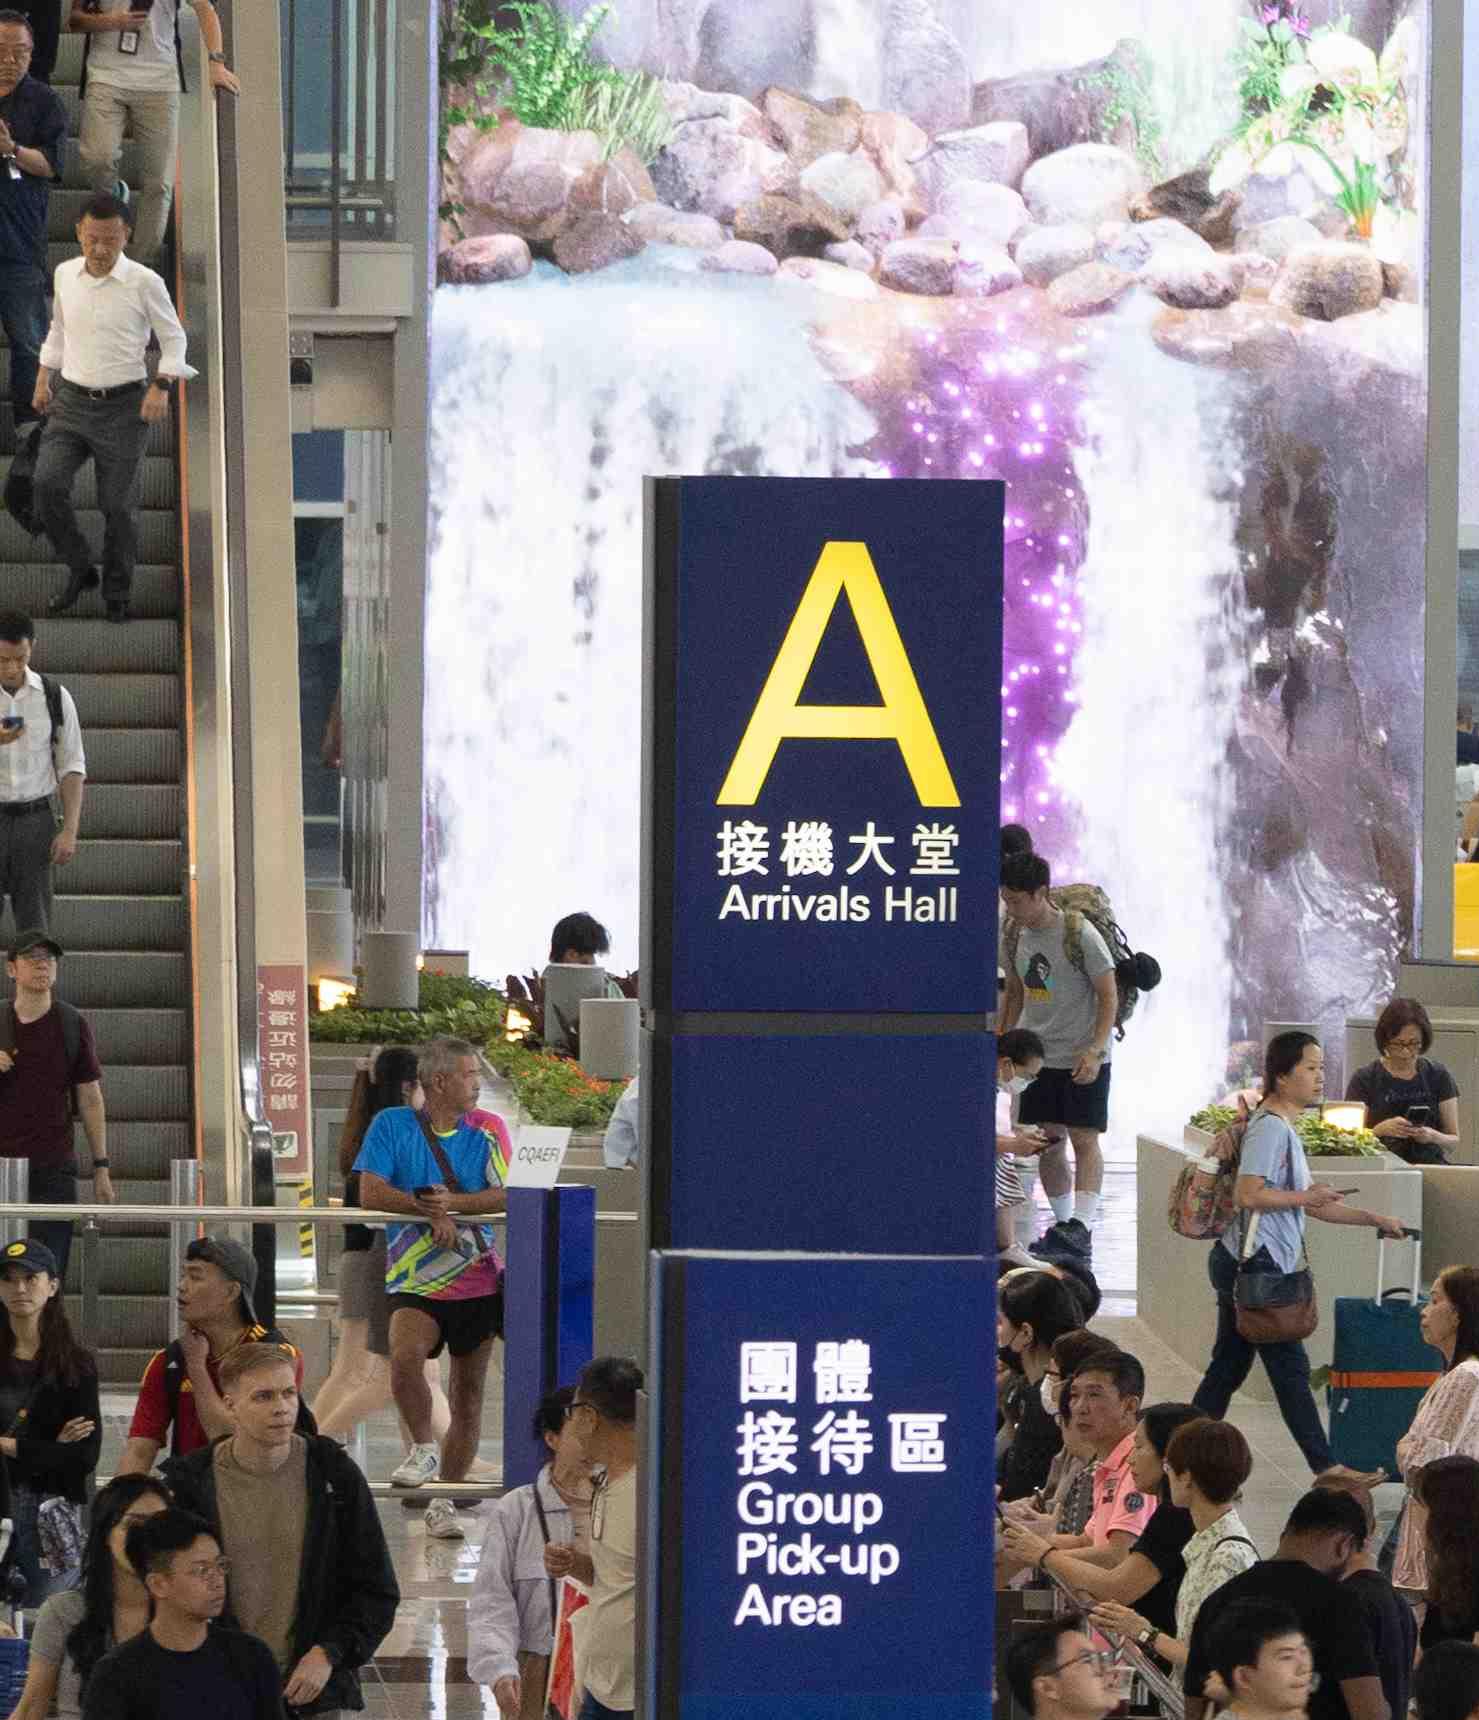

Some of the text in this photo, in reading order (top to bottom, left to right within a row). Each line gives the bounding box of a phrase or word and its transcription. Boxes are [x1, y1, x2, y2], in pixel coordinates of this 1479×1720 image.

[716, 541, 961, 808] A
[716, 821, 961, 877] 接機大堂
[718, 884, 959, 923] Arrivals Hall
[739, 1338, 873, 1405] 團體
[735, 1410, 948, 1477] 接待區
[737, 1482, 883, 1534] Group
[736, 1532, 901, 1585] Pick-up
[734, 1583, 843, 1627] Area
